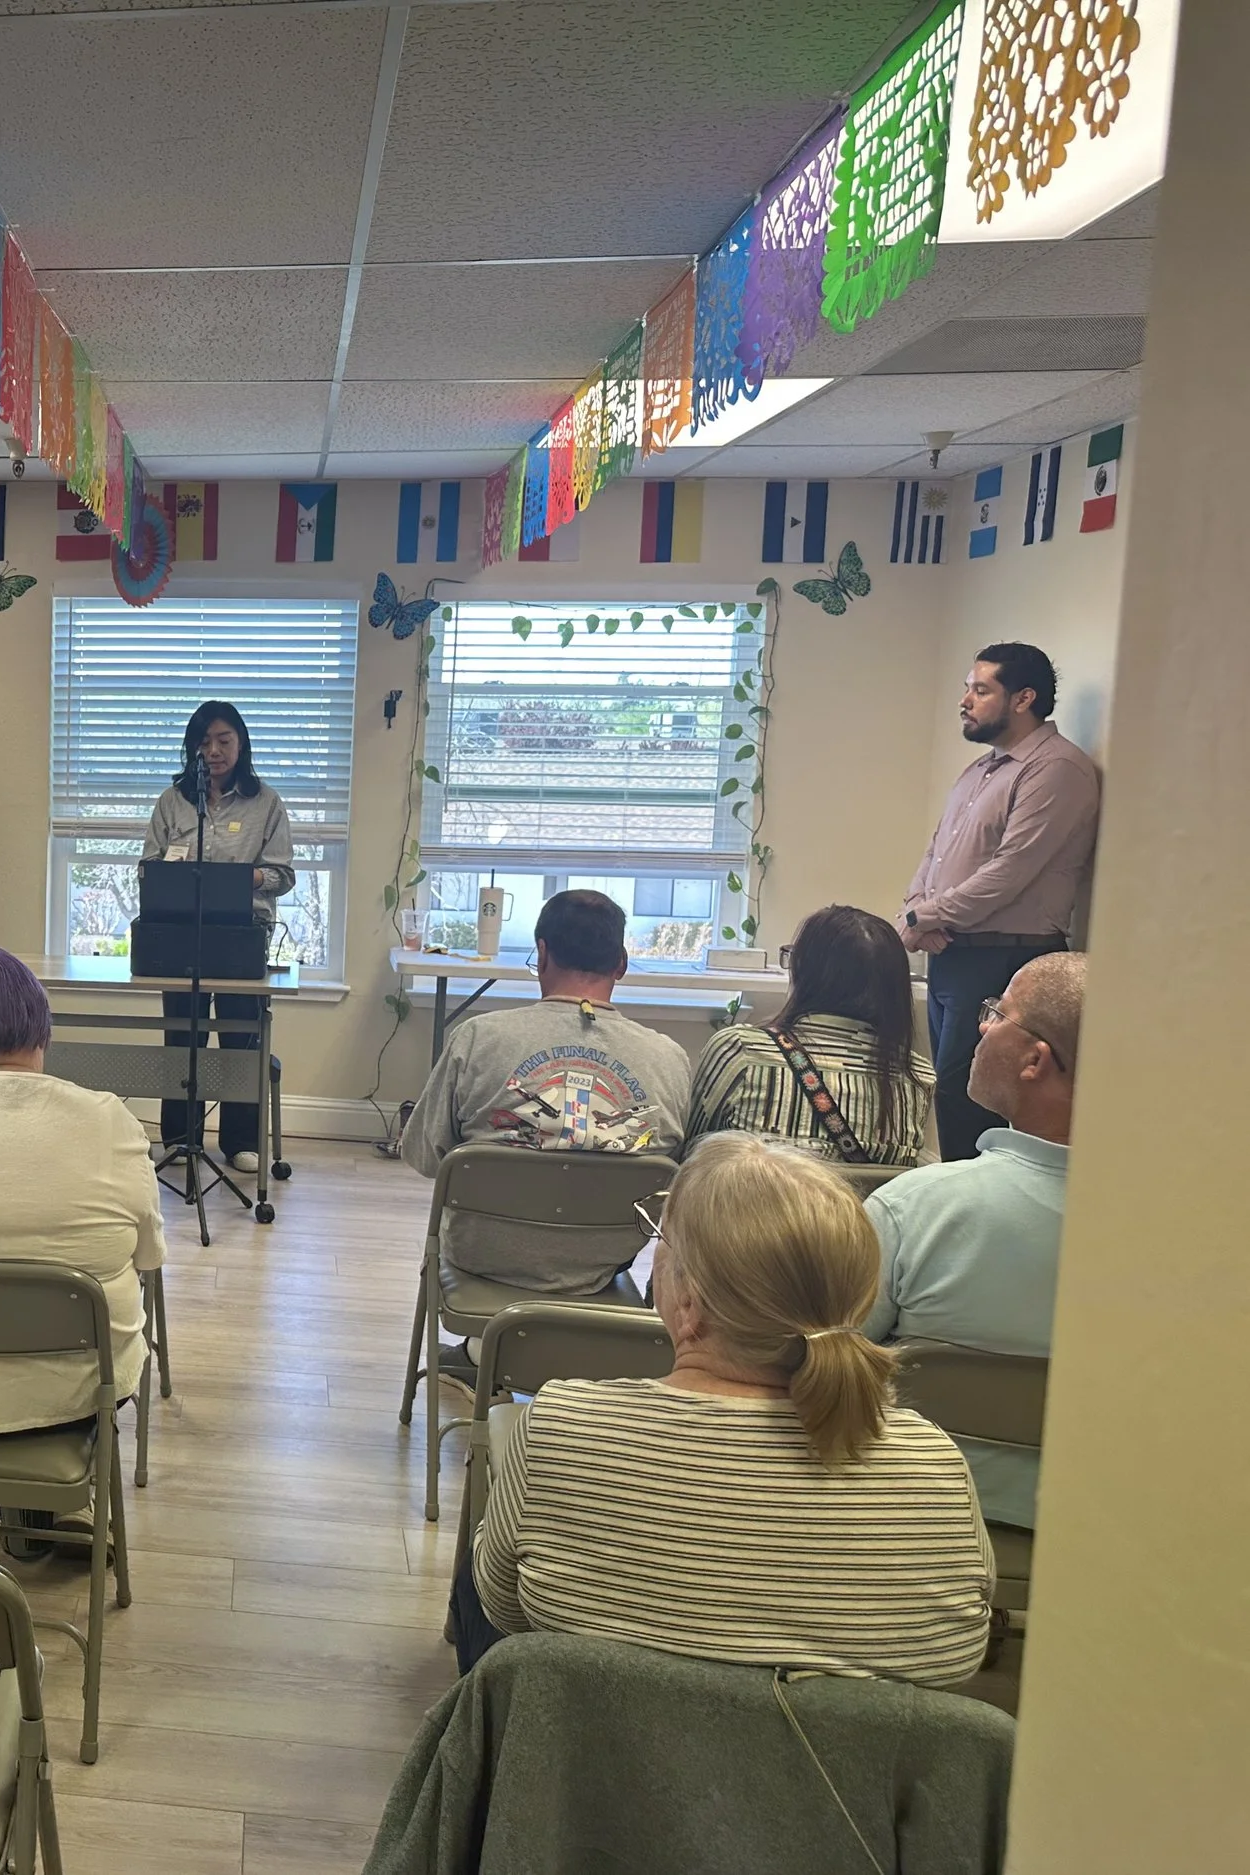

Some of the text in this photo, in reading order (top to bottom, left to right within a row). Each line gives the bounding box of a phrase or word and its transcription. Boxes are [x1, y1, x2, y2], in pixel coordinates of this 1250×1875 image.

[514, 1046, 646, 1102] THE FINAL FLAG
[567, 1075, 591, 1087] 2023
